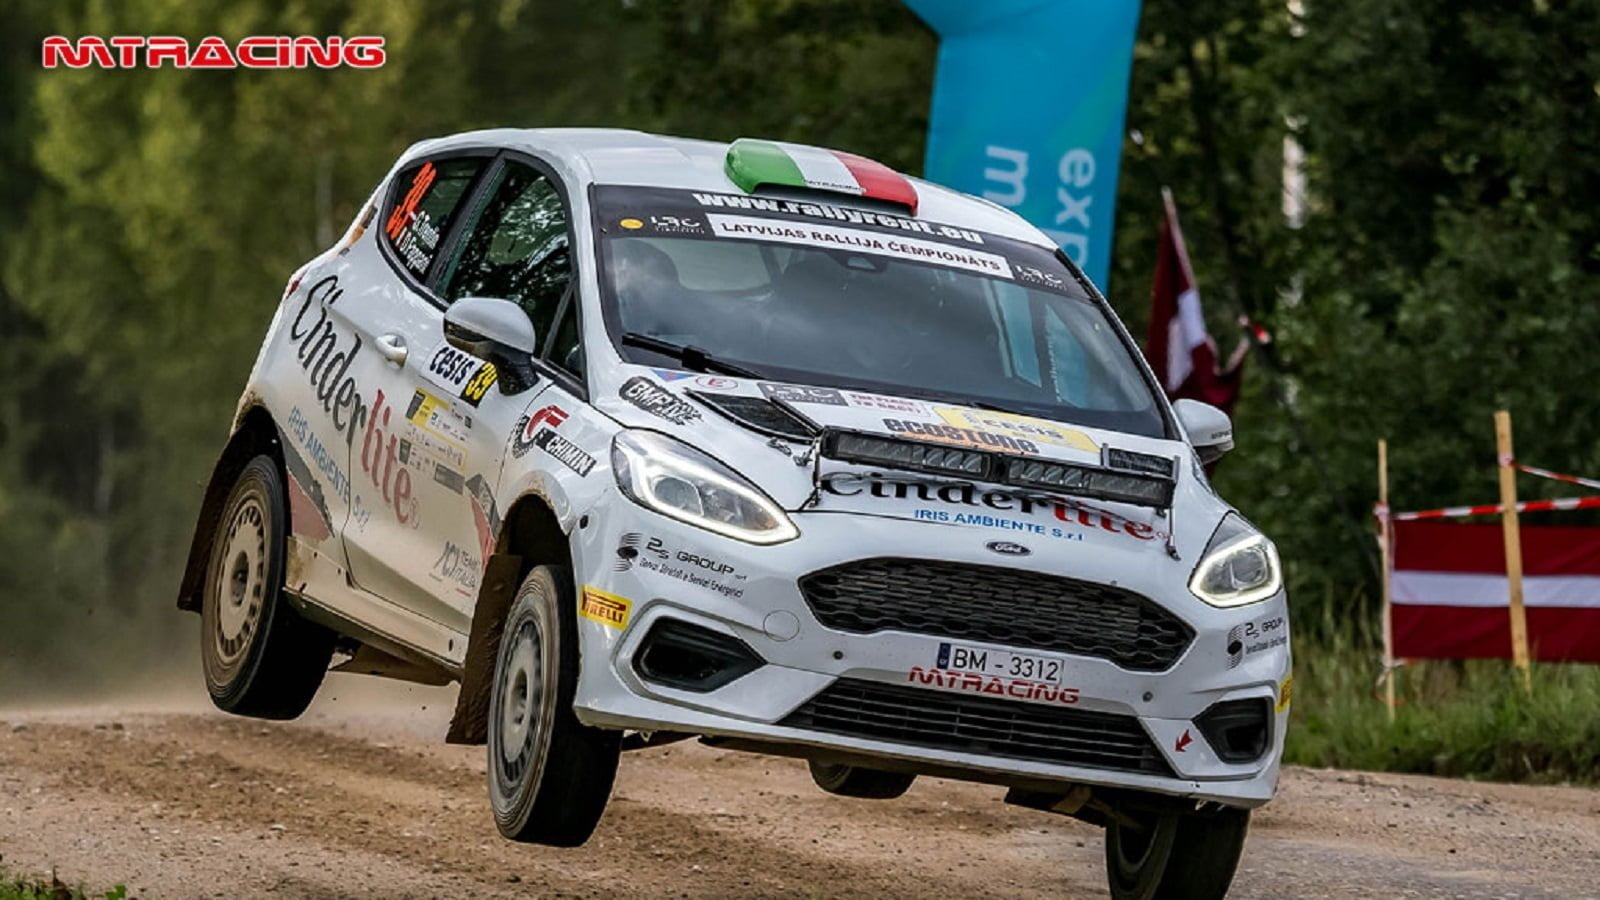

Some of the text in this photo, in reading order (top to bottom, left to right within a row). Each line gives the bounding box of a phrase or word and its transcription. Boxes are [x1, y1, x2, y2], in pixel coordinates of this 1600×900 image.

[692, 192, 985, 245] www.rallyrent.eu
[721, 223, 807, 239] LATVIJAS
[811, 231, 886, 252] RALLIJA
[466, 362, 498, 401] 39
[290, 274, 412, 526] Cinderlite
[914, 508, 951, 523] IRIS
[953, 512, 1047, 536] AMBIENTE
[676, 550, 735, 576] GROUP
[581, 590, 627, 624] PIRELLI
[953, 648, 987, 671] BM
[1009, 656, 1060, 682] 3312
[908, 667, 1081, 704] MTRACING
